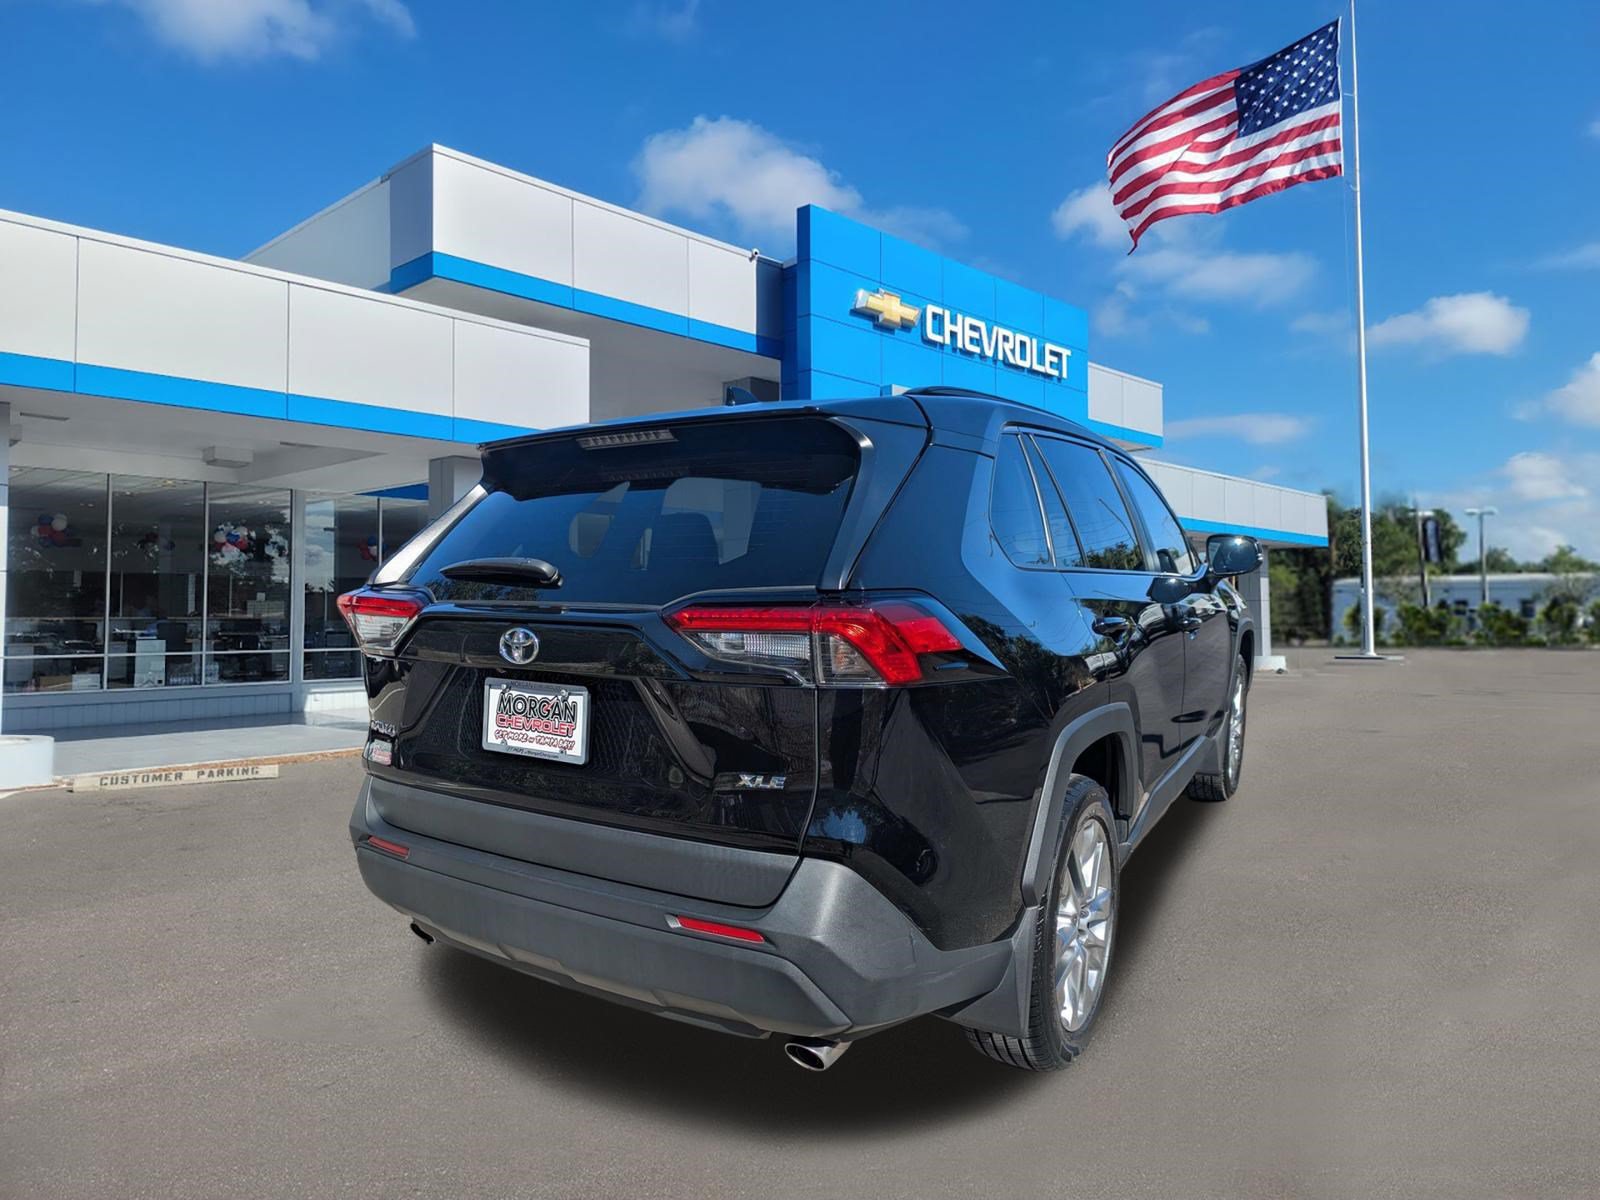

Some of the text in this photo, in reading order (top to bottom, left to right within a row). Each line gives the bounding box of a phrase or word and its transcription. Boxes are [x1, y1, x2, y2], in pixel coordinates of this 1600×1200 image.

[924, 304, 1072, 379] CHEVROLET
[497, 692, 577, 724] MORGAN
[496, 713, 576, 738] CHEVROLET
[507, 730, 528, 743] MORE
[535, 735, 559, 749] TAMPA
[100, 766, 260, 787] CUSTOMER PARKING
[736, 774, 786, 790] XLE
